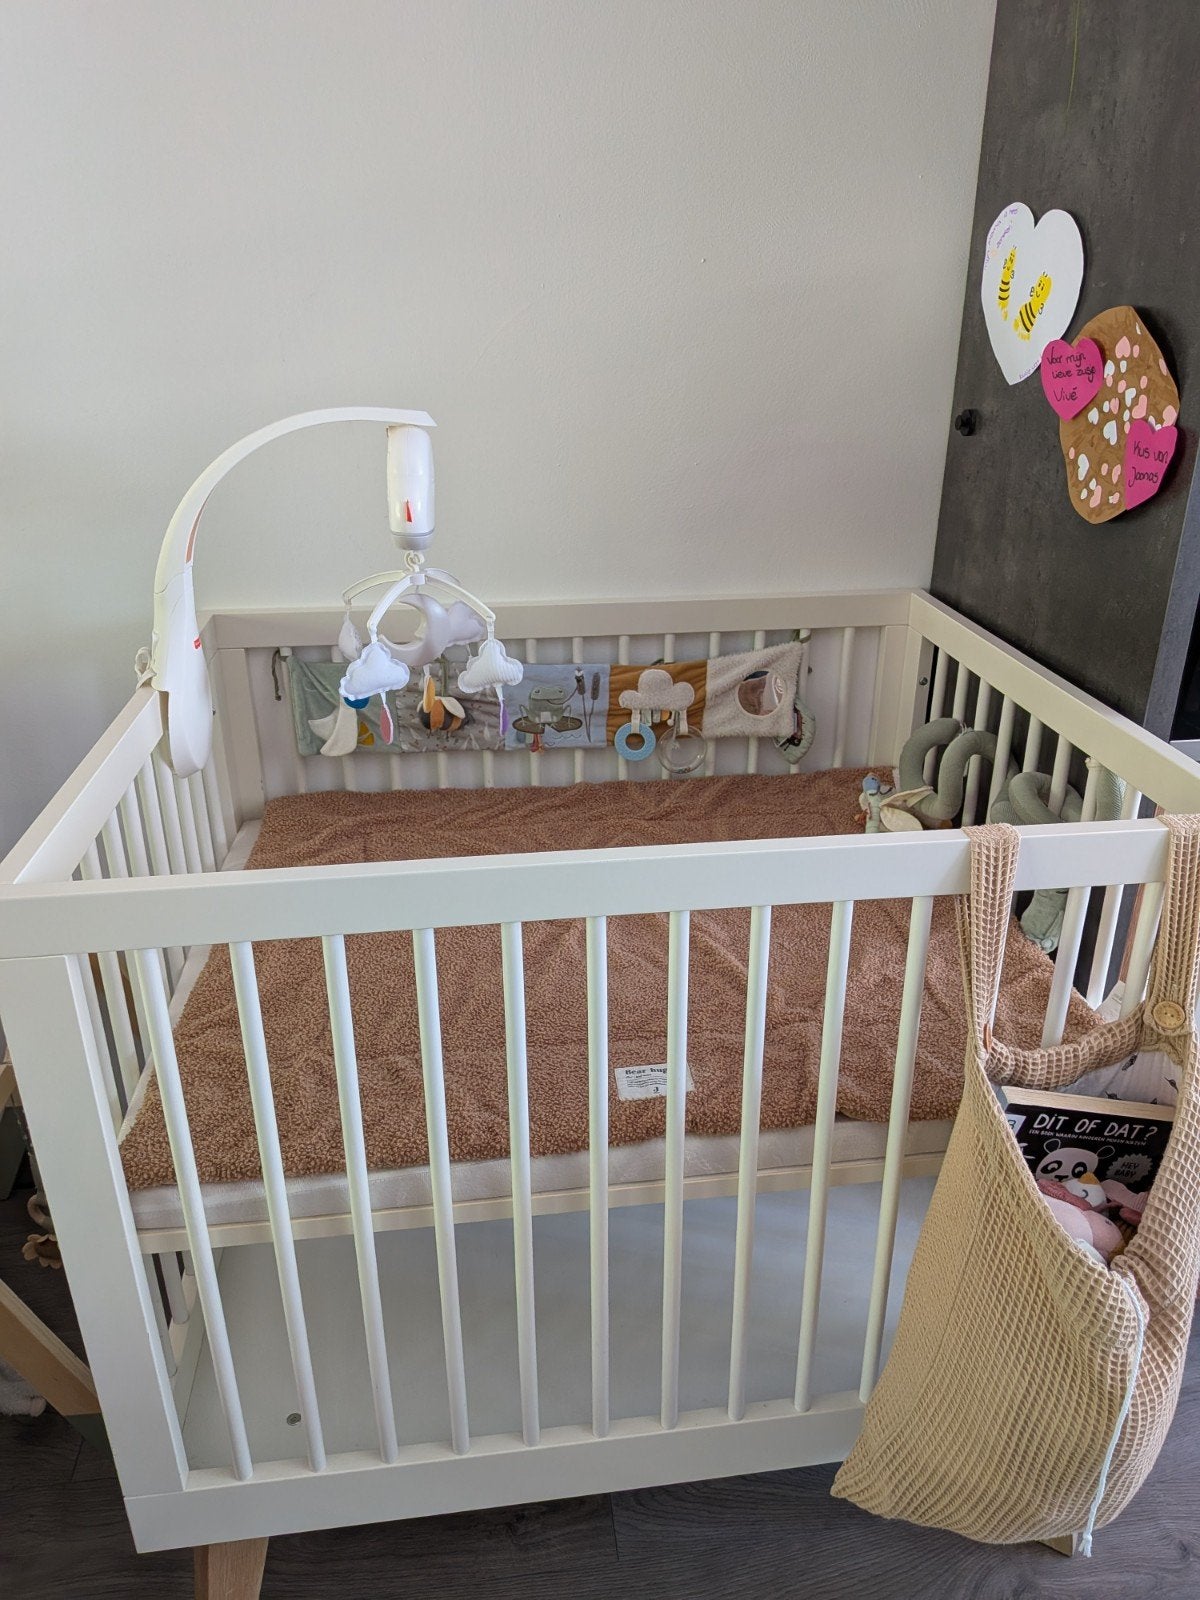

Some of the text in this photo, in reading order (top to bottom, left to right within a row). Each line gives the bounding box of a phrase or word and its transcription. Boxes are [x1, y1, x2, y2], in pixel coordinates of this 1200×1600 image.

[1047, 346, 1086, 368] Voor mijn
[1052, 369, 1073, 379] lieve
[1133, 440, 1169, 464] Kus van
[1033, 1113, 1069, 1130] DIT
[1074, 1118, 1101, 1134] OF
[1121, 1161, 1140, 1169] HEY
[1114, 1169, 1137, 1178] BABY
